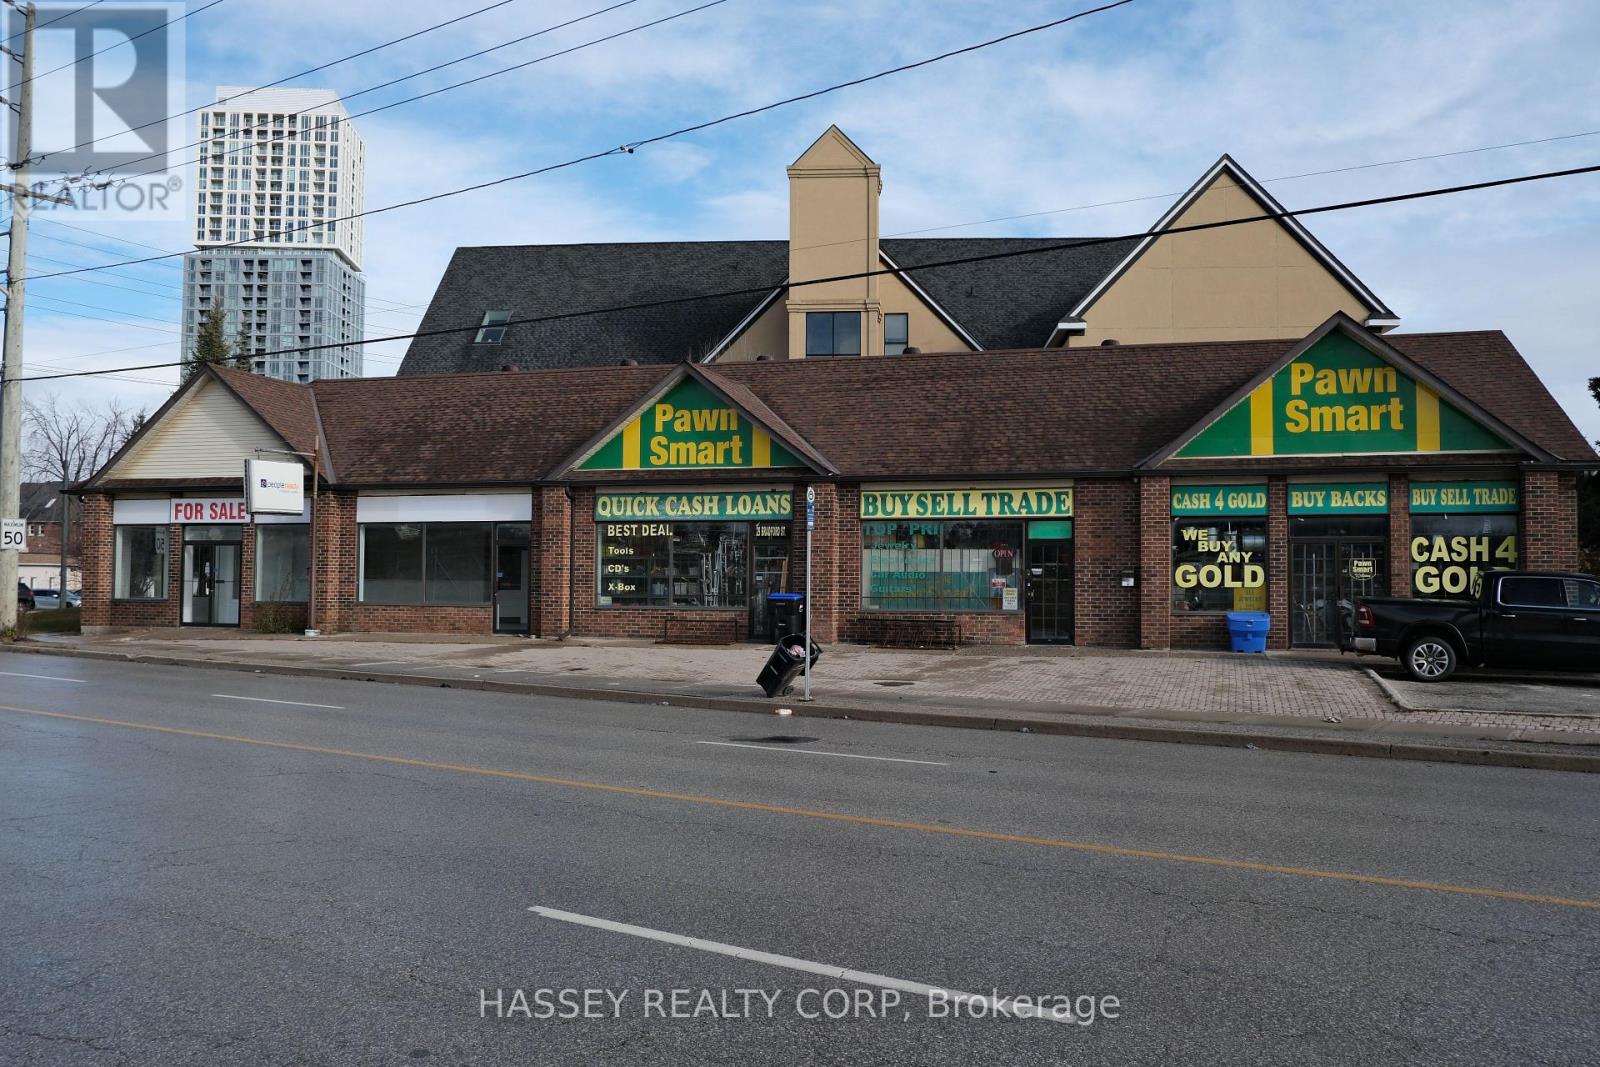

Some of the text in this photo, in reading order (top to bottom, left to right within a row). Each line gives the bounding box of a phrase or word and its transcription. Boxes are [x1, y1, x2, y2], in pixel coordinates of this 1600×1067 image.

[1291, 362, 1396, 396] Pawn
[655, 403, 738, 433] Pawn
[1285, 397, 1404, 433] Smart
[650, 435, 742, 466] Smart
[862, 491, 1071, 517] BUY SELL TRADE
[1173, 489, 1267, 511] CASH 4 GOLD
[1291, 490, 1386, 508] BUY BACKS
[1412, 487, 1516, 505] BUY SELL TRADE
[174, 502, 246, 521] FOR SALE
[597, 494, 791, 517] QUICK CASH LOANS
[4, 531, 23, 545] 50
[607, 524, 638, 537] BEST
[864, 522, 897, 536] TOP
[1182, 529, 1208, 541] WE
[607, 546, 634, 555] Tools
[1197, 540, 1233, 552] BUY
[1411, 535, 1518, 563] CASH 4
[1216, 552, 1253, 563] ANY
[607, 564, 630, 573] CD's
[1174, 564, 1265, 588] GOLD
[607, 582, 636, 591] X-Box
